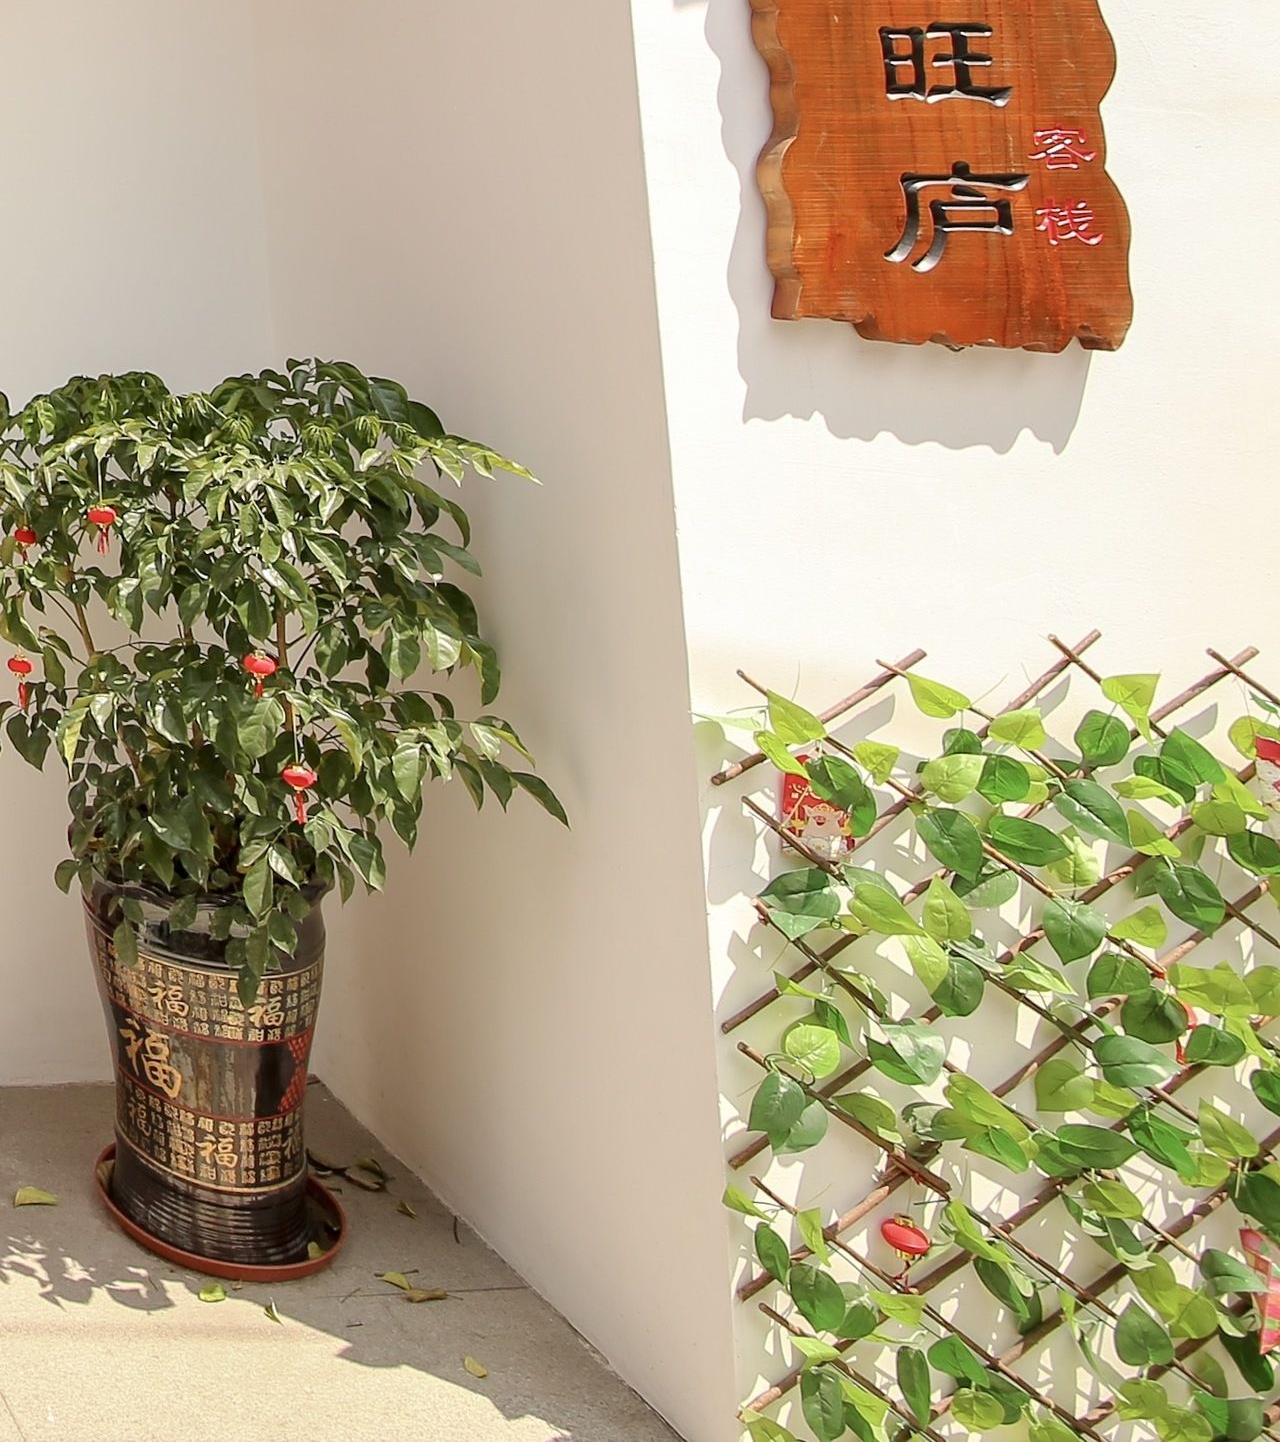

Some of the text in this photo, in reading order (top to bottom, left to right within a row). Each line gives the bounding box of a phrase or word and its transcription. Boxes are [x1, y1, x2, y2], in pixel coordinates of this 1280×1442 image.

[1027, 124, 1104, 246] 客栈
[148, 982, 190, 1018] 福
[248, 996, 286, 1028] 福
[120, 1017, 184, 1099] 福
[197, 1135, 239, 1169] 福
